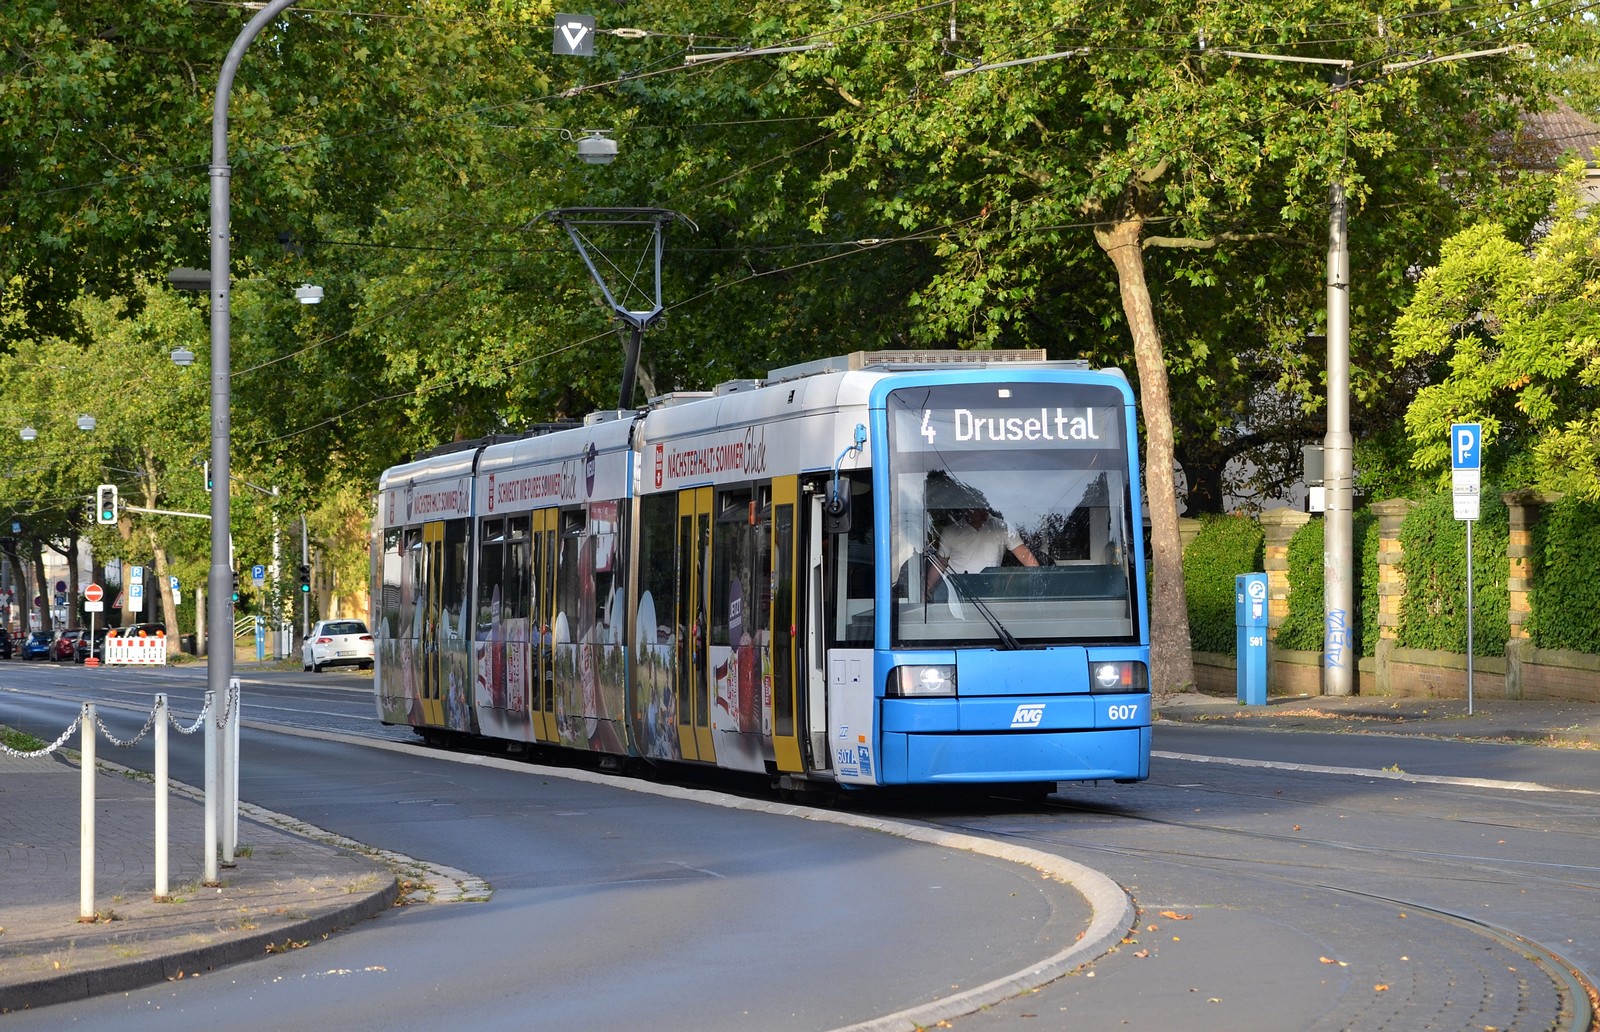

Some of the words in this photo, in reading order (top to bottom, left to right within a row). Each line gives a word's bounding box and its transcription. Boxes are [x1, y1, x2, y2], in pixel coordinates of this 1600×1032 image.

[920, 409, 937, 445] 4
[954, 407, 1100, 441] Druseltal
[1457, 429, 1475, 464] P
[667, 448, 698, 479] NÄCHSTER
[715, 442, 743, 473] SOMMER
[254, 567, 262, 578] P
[1249, 636, 1263, 647] 501
[1012, 706, 1043, 725] KVG
[1108, 704, 1138, 720] 607
[837, 749, 858, 764] 607A
